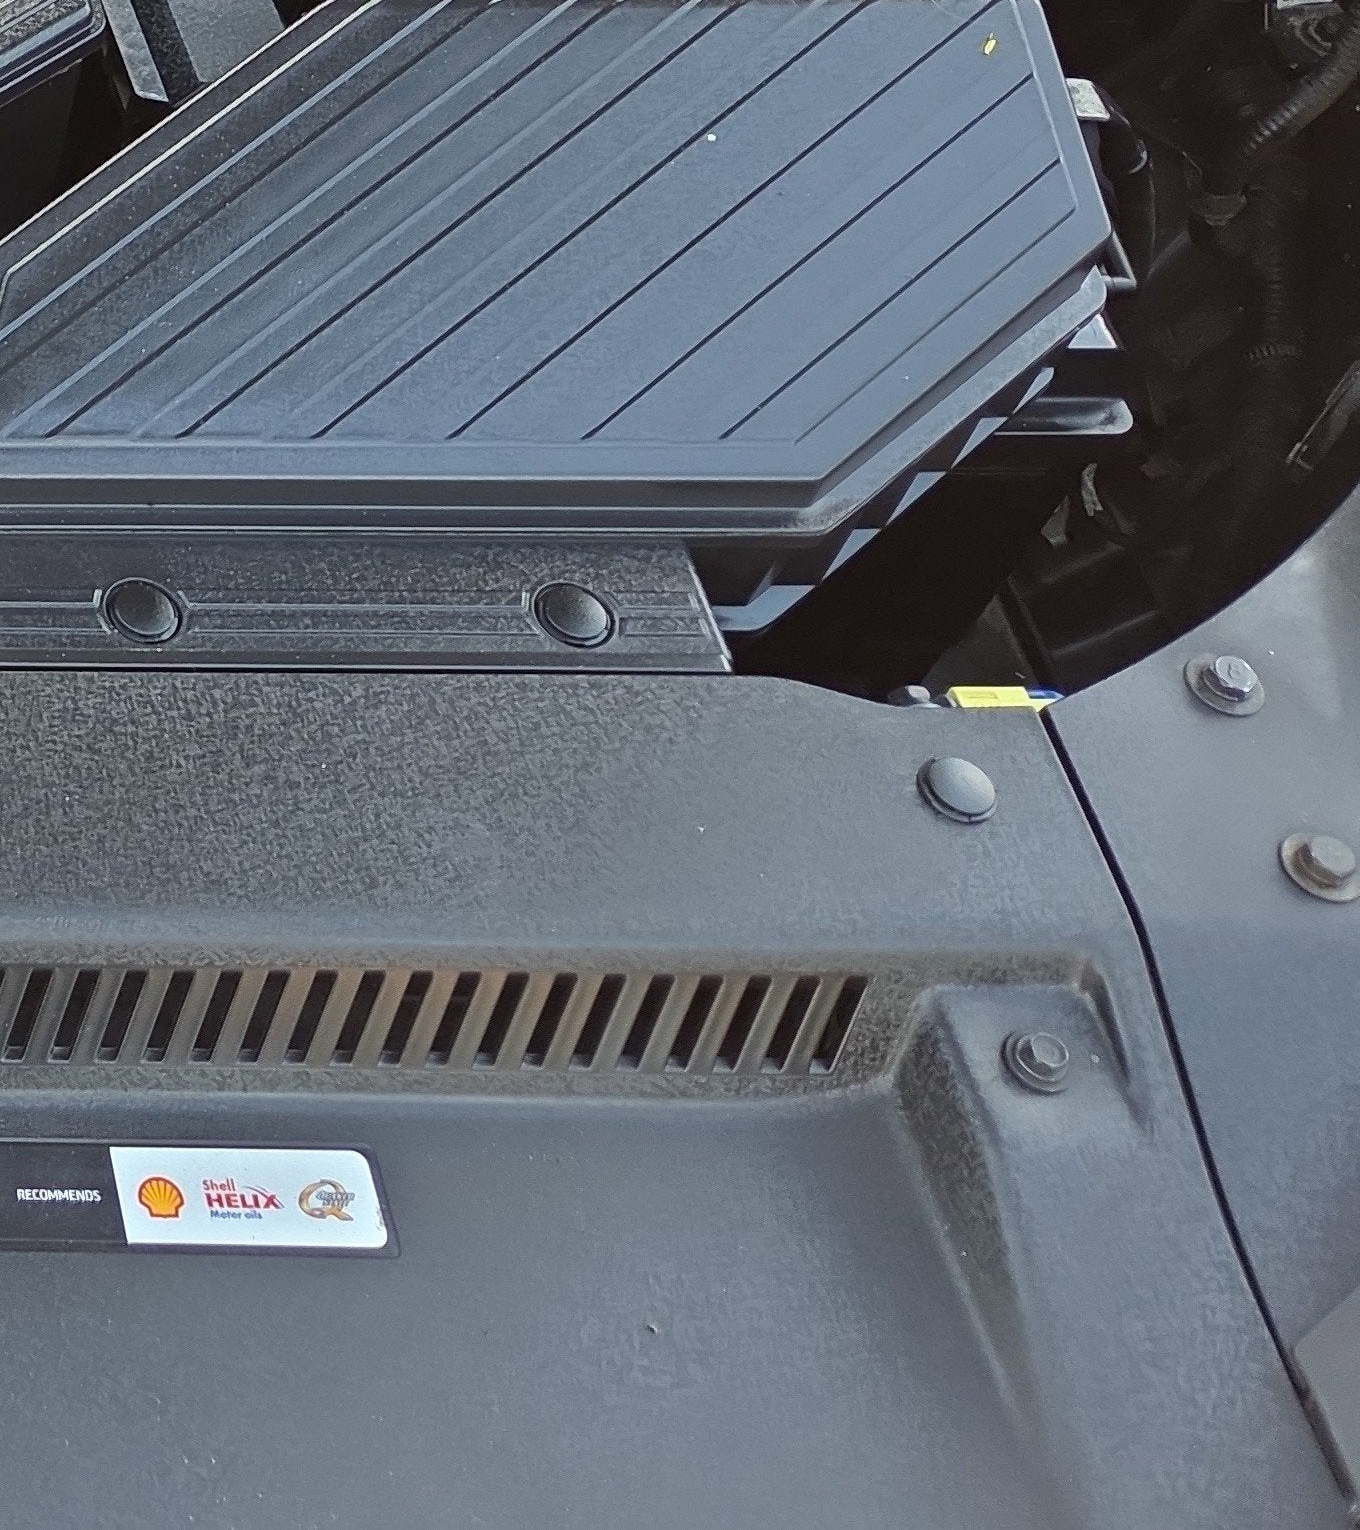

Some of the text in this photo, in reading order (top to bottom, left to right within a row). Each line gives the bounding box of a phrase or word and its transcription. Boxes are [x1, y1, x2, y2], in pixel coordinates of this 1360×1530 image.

[202, 1178, 236, 1191] Shell
[16, 1188, 102, 1202] RECOMMENDS
[205, 1192, 283, 1209] HELIX
